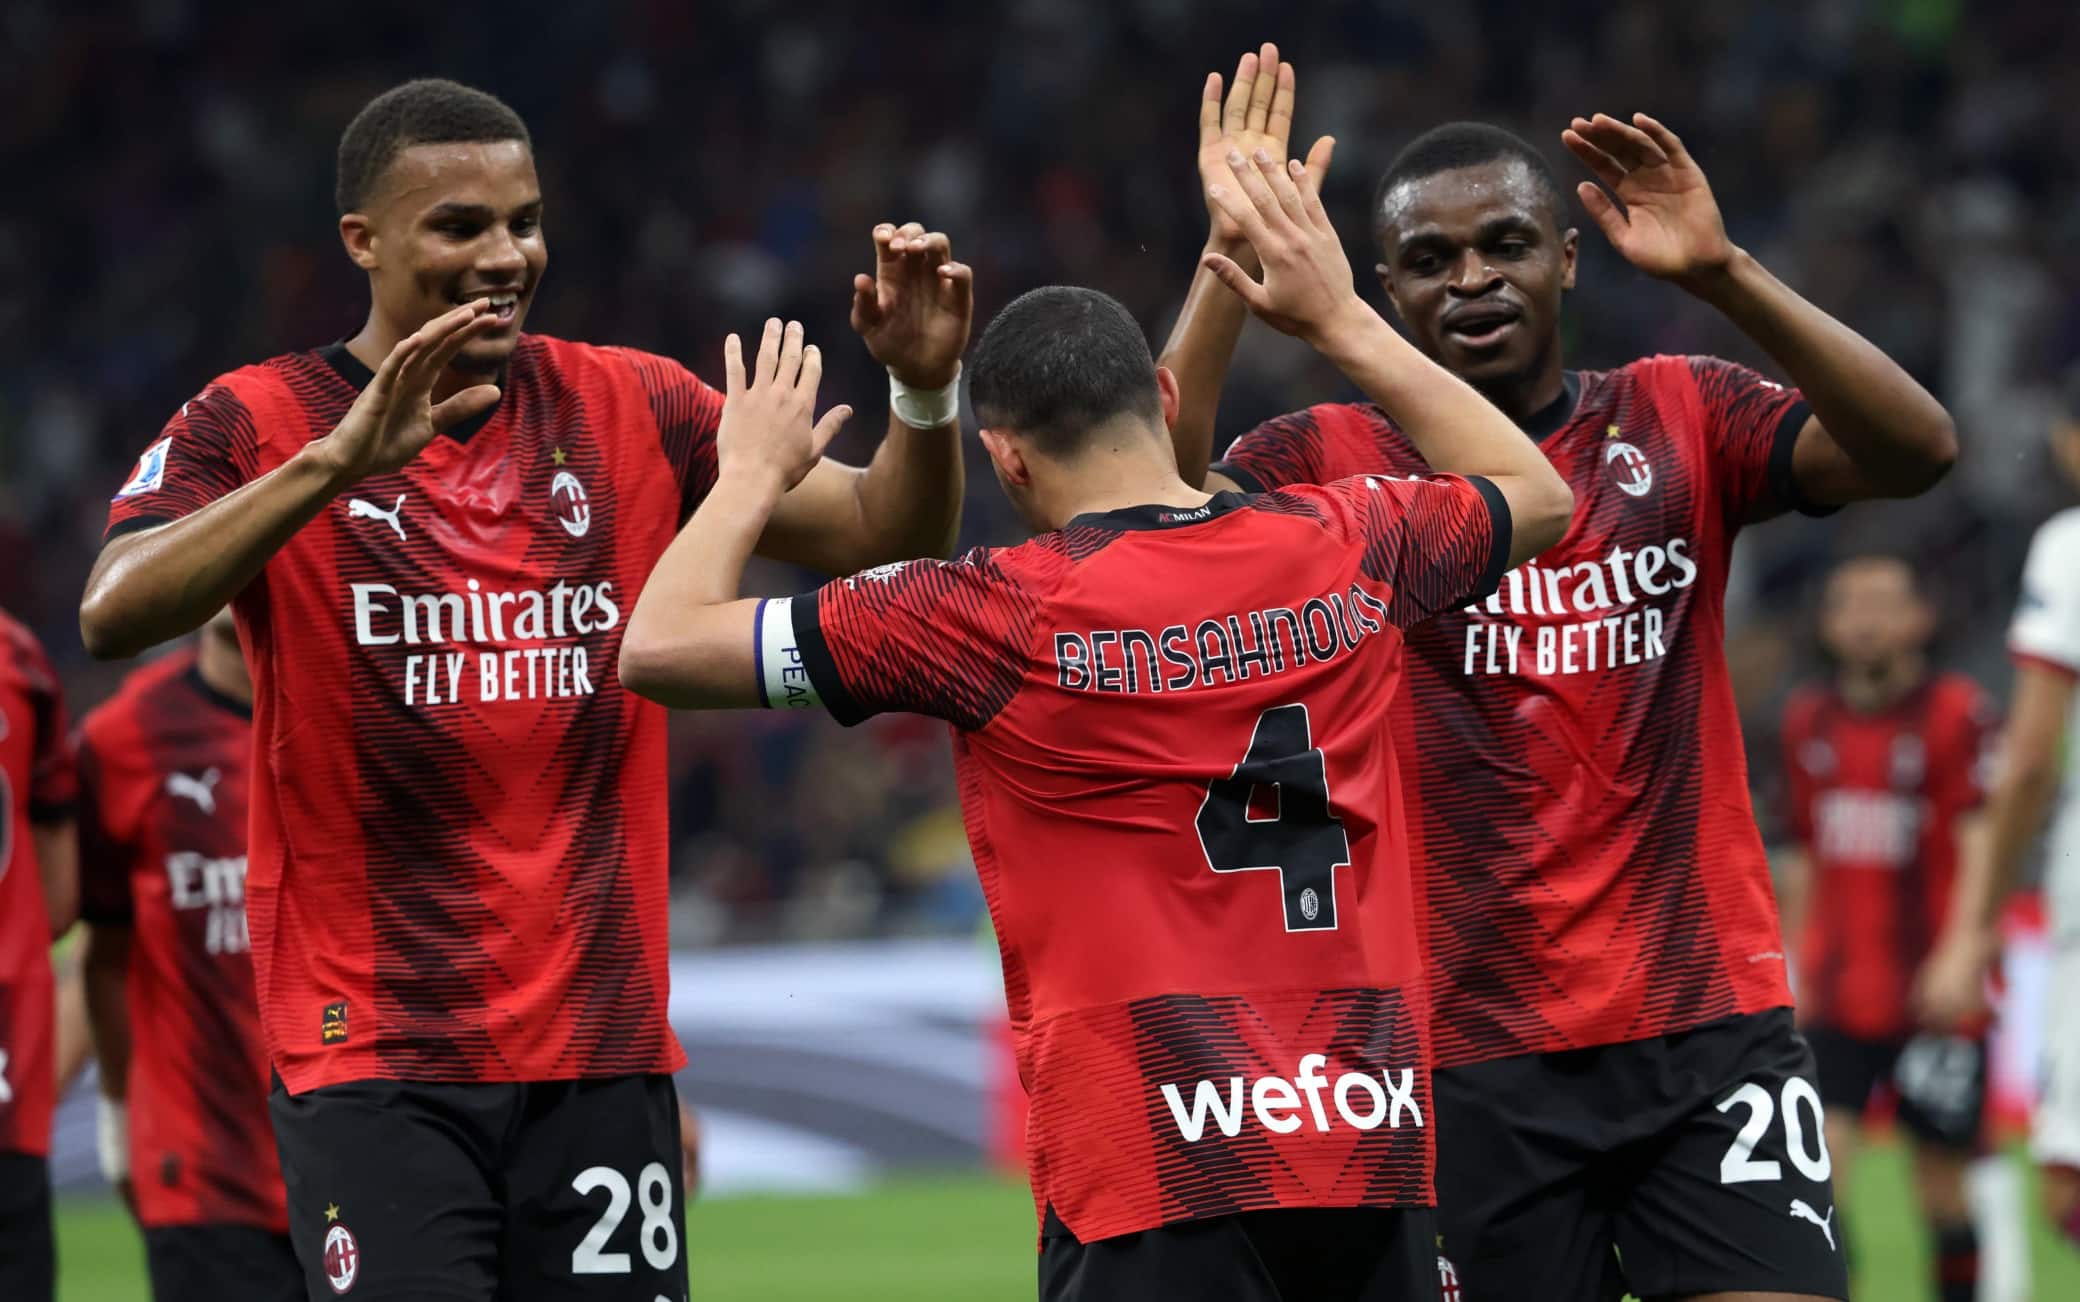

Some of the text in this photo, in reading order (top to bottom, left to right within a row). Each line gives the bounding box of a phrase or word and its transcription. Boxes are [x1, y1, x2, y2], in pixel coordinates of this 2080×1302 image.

[351, 578, 620, 645] Emirates
[1464, 538, 1697, 615] mirates
[405, 646, 594, 705] FLY BETTER
[1464, 607, 1666, 675] FLY BETTER
[1194, 702, 1350, 932] 4
[1160, 1053, 1424, 1142] wefox
[1715, 1076, 1831, 1184] 20
[572, 1162, 678, 1274] 28
